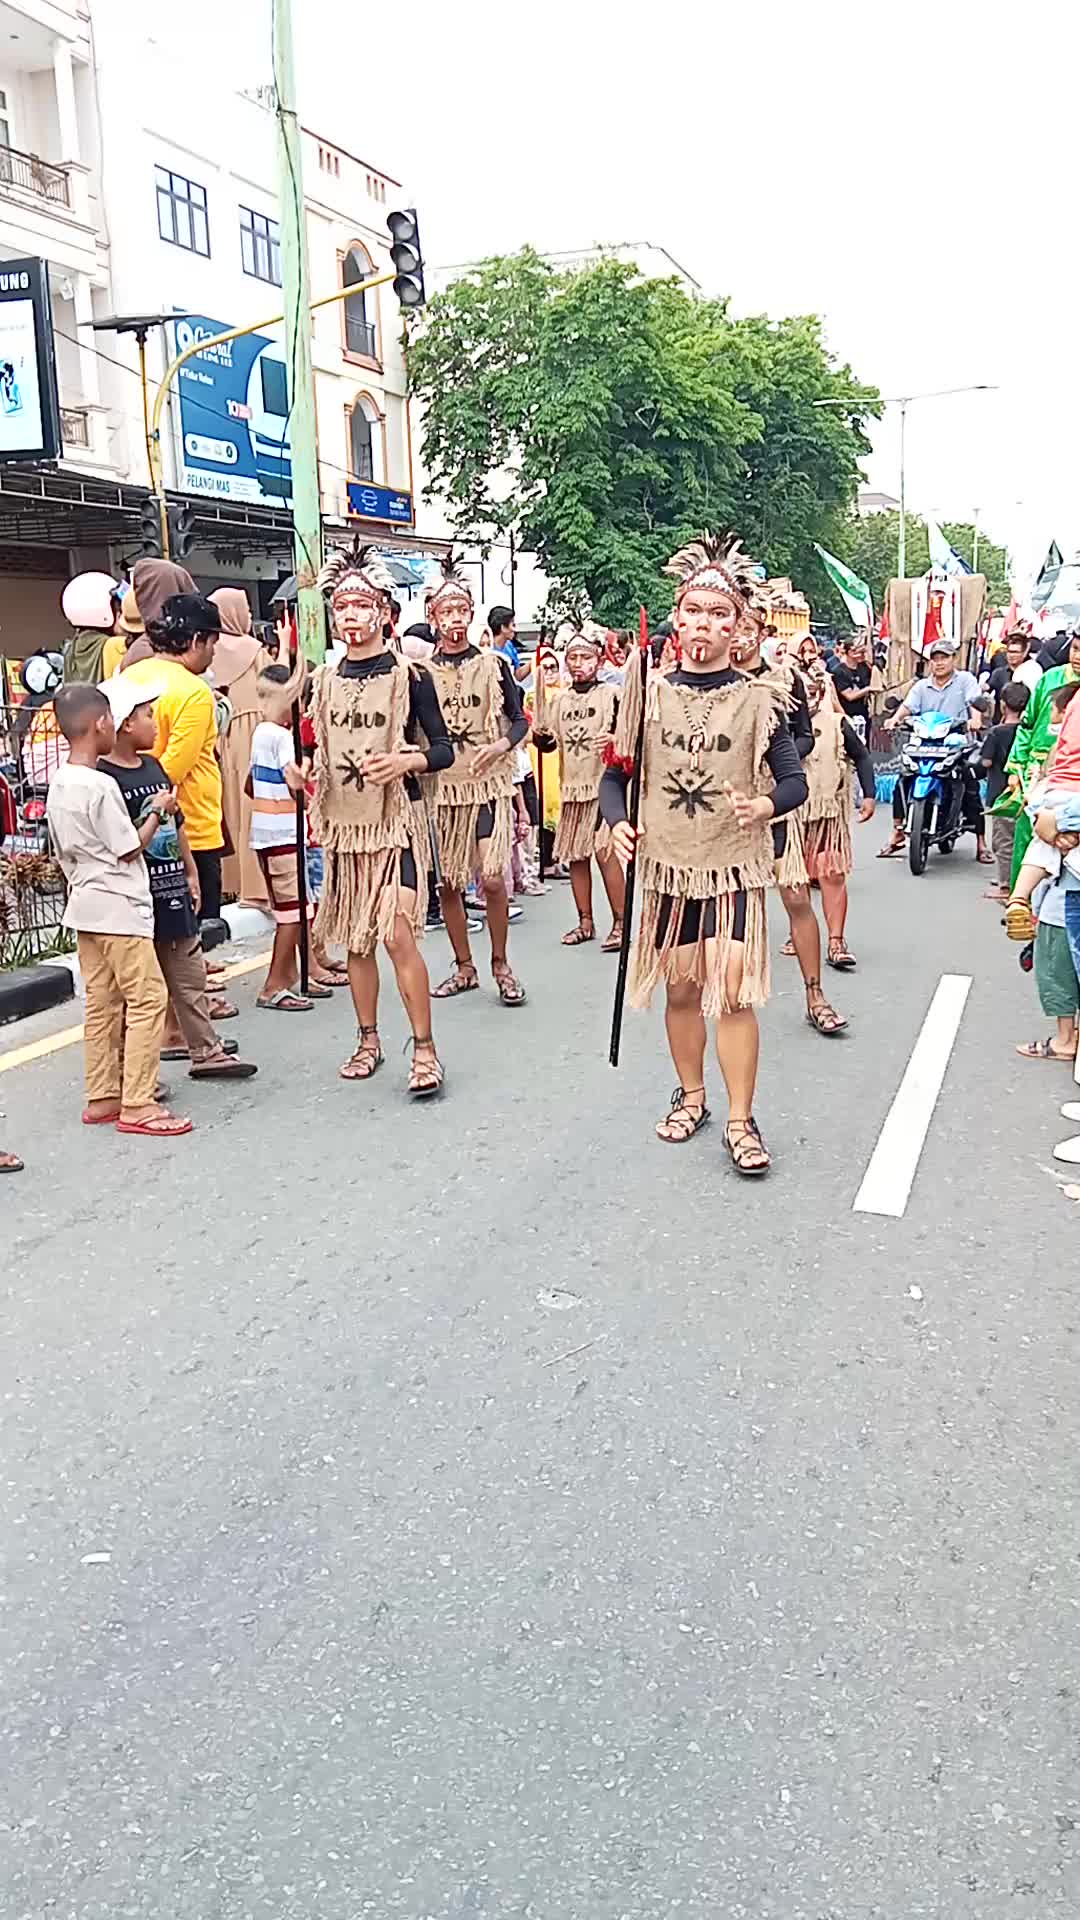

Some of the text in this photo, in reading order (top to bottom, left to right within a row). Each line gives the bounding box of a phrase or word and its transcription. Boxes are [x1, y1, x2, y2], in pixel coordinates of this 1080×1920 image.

[187, 473, 216, 491] PELANGI
[216, 479, 231, 493] MAS
[330, 709, 387, 729] KABUD
[661, 727, 732, 753] KAUD
